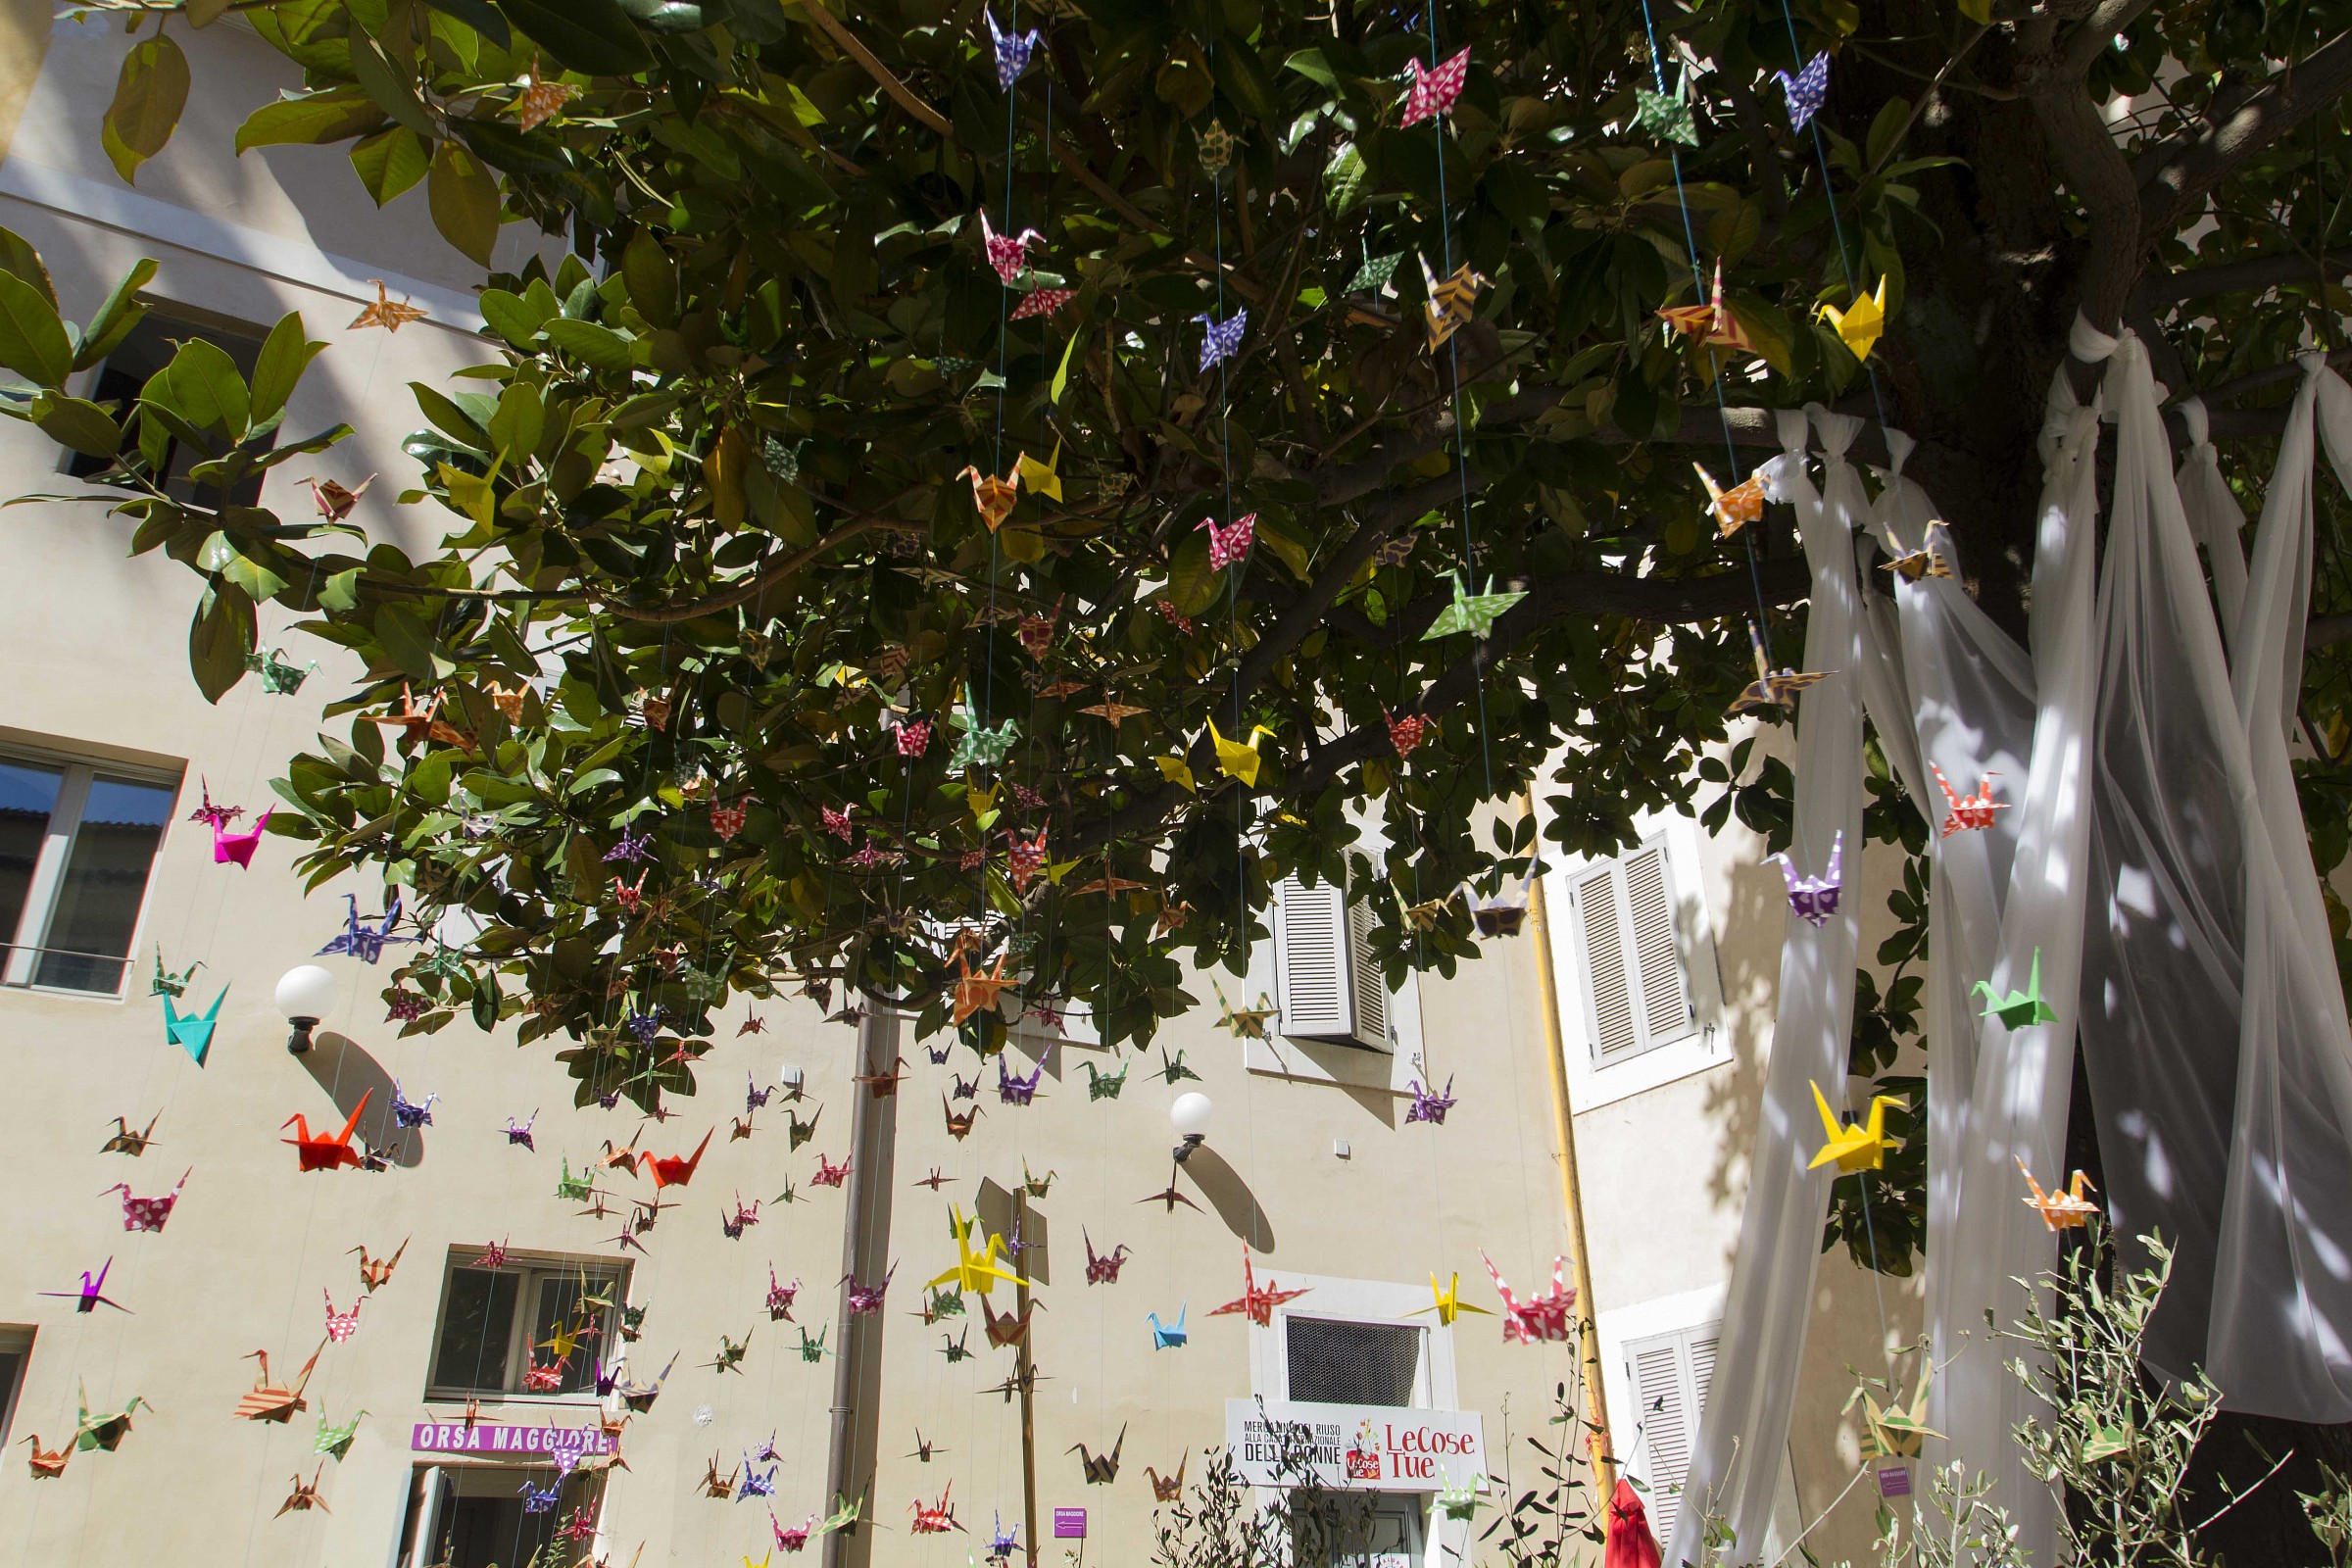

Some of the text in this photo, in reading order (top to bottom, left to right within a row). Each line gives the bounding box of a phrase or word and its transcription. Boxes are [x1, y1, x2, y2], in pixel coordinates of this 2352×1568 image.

[419, 1425, 609, 1452] ORSA MAGGIORE
[1245, 1433, 1262, 1444] ALLA
[1315, 1423, 1341, 1437] RIUSO
[1385, 1424, 1475, 1455] LeCose
[1386, 1450, 1436, 1479] Tue
